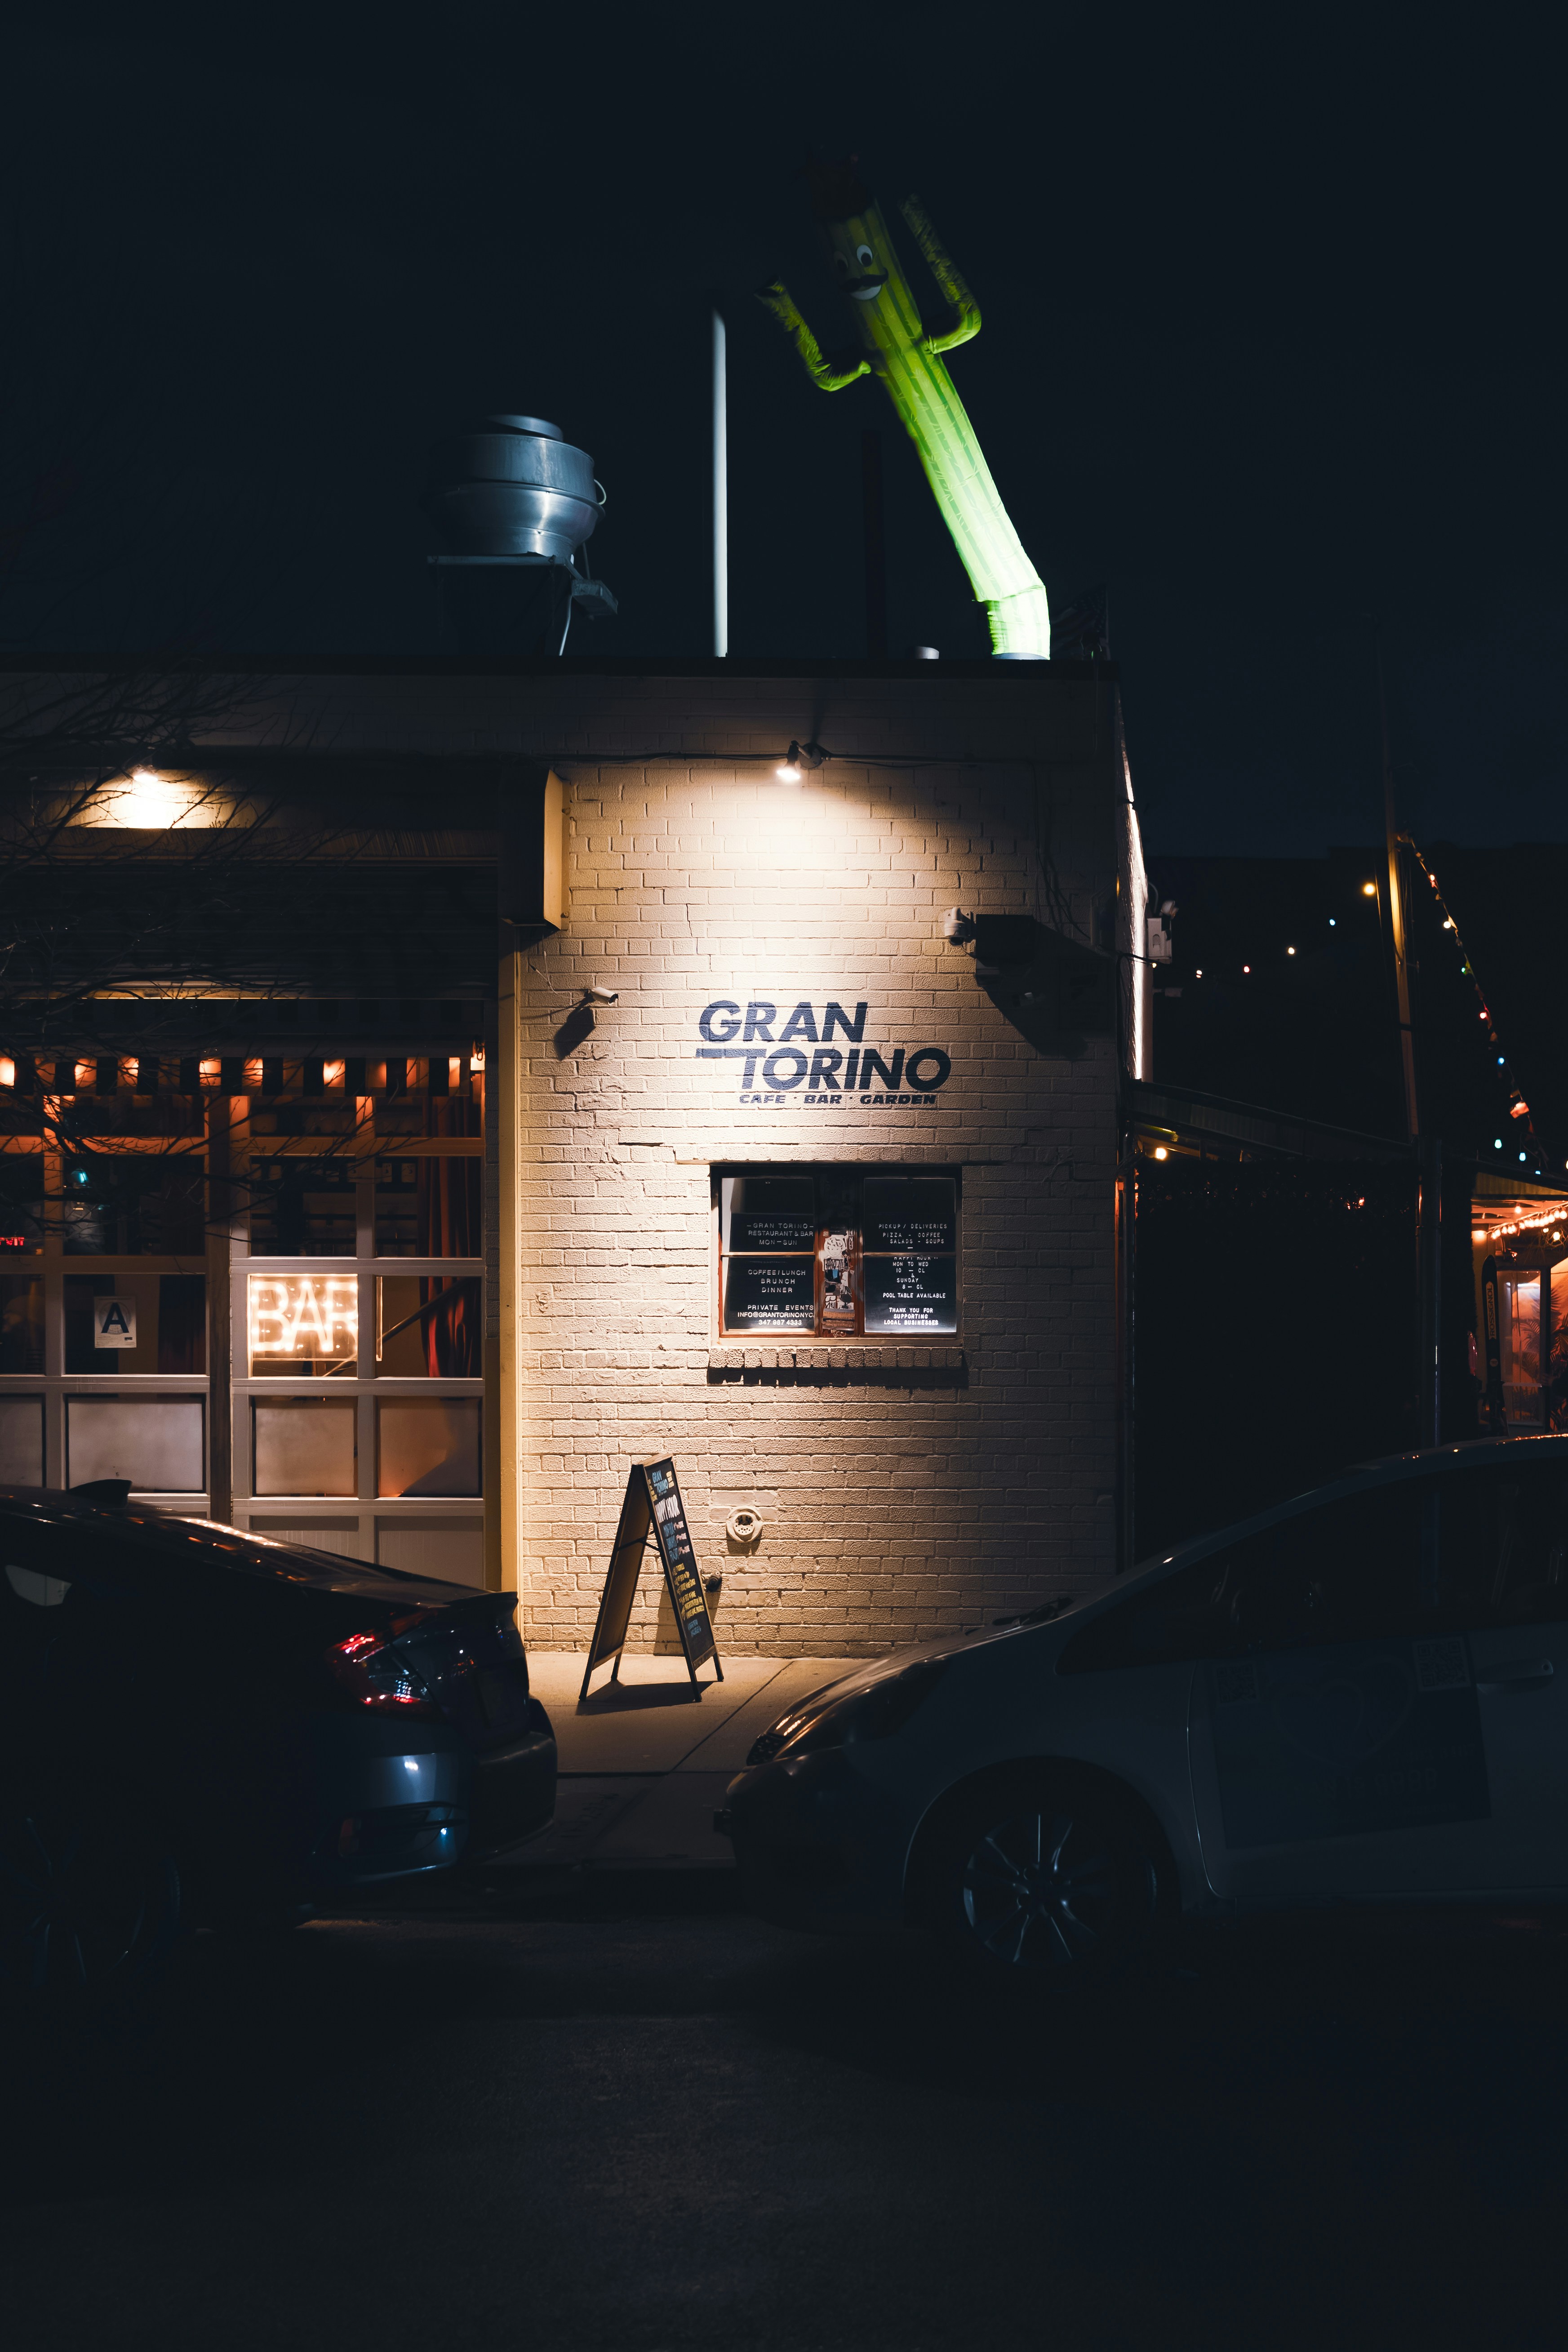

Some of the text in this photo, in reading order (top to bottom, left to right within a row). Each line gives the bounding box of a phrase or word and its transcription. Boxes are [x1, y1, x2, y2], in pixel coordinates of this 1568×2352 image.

[699, 1000, 868, 1042] GRAN
[695, 1047, 951, 1091] TORINO
[739, 1094, 936, 1104] CAFE BAR GARDEN
[101, 1303, 129, 1334] A
[251, 1281, 359, 1352] BAR
